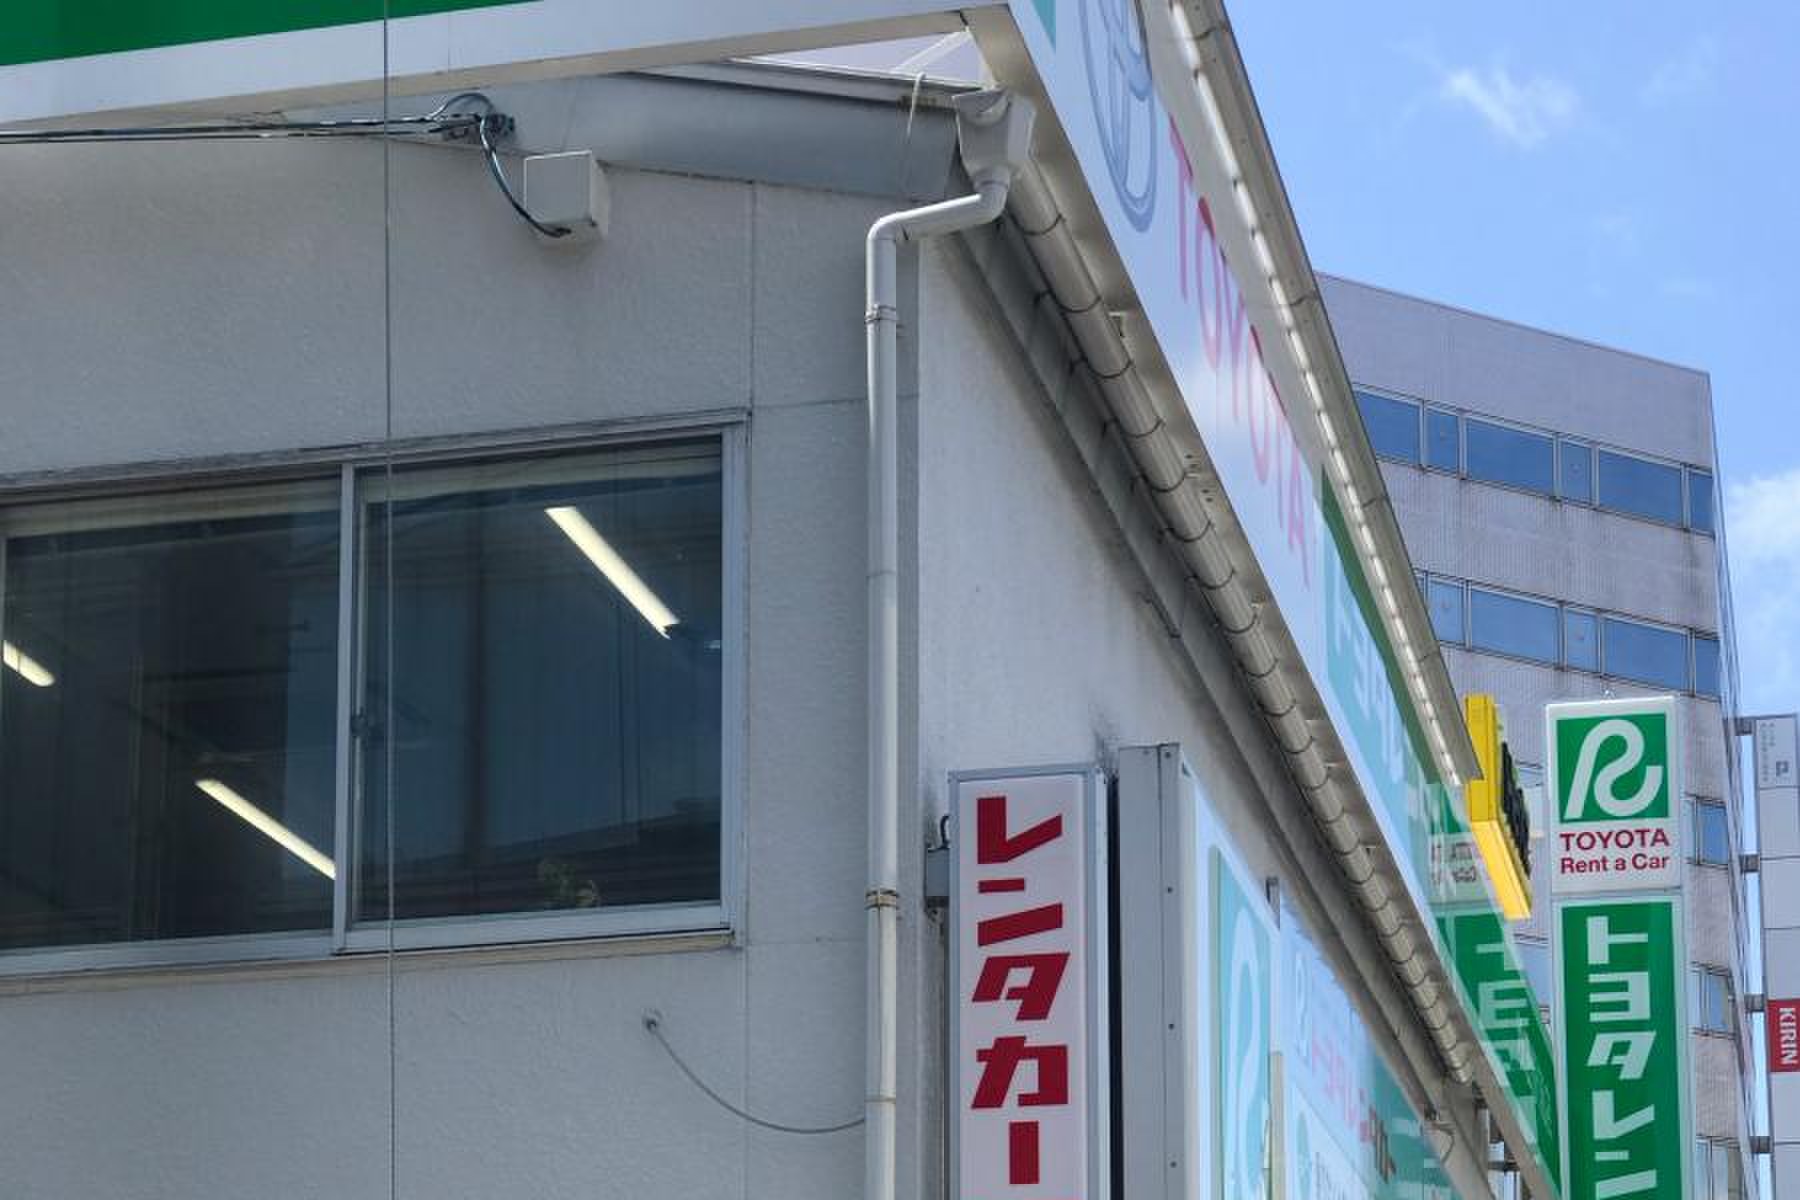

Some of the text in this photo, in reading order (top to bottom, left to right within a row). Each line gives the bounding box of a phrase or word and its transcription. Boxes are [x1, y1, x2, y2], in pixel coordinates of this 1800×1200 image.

[1559, 828, 1671, 852] TOYOTA
[1560, 852, 1671, 875] Rent a Car
[971, 796, 1070, 1185] レンタカー
[1779, 1007, 1798, 1065] KIRIN
